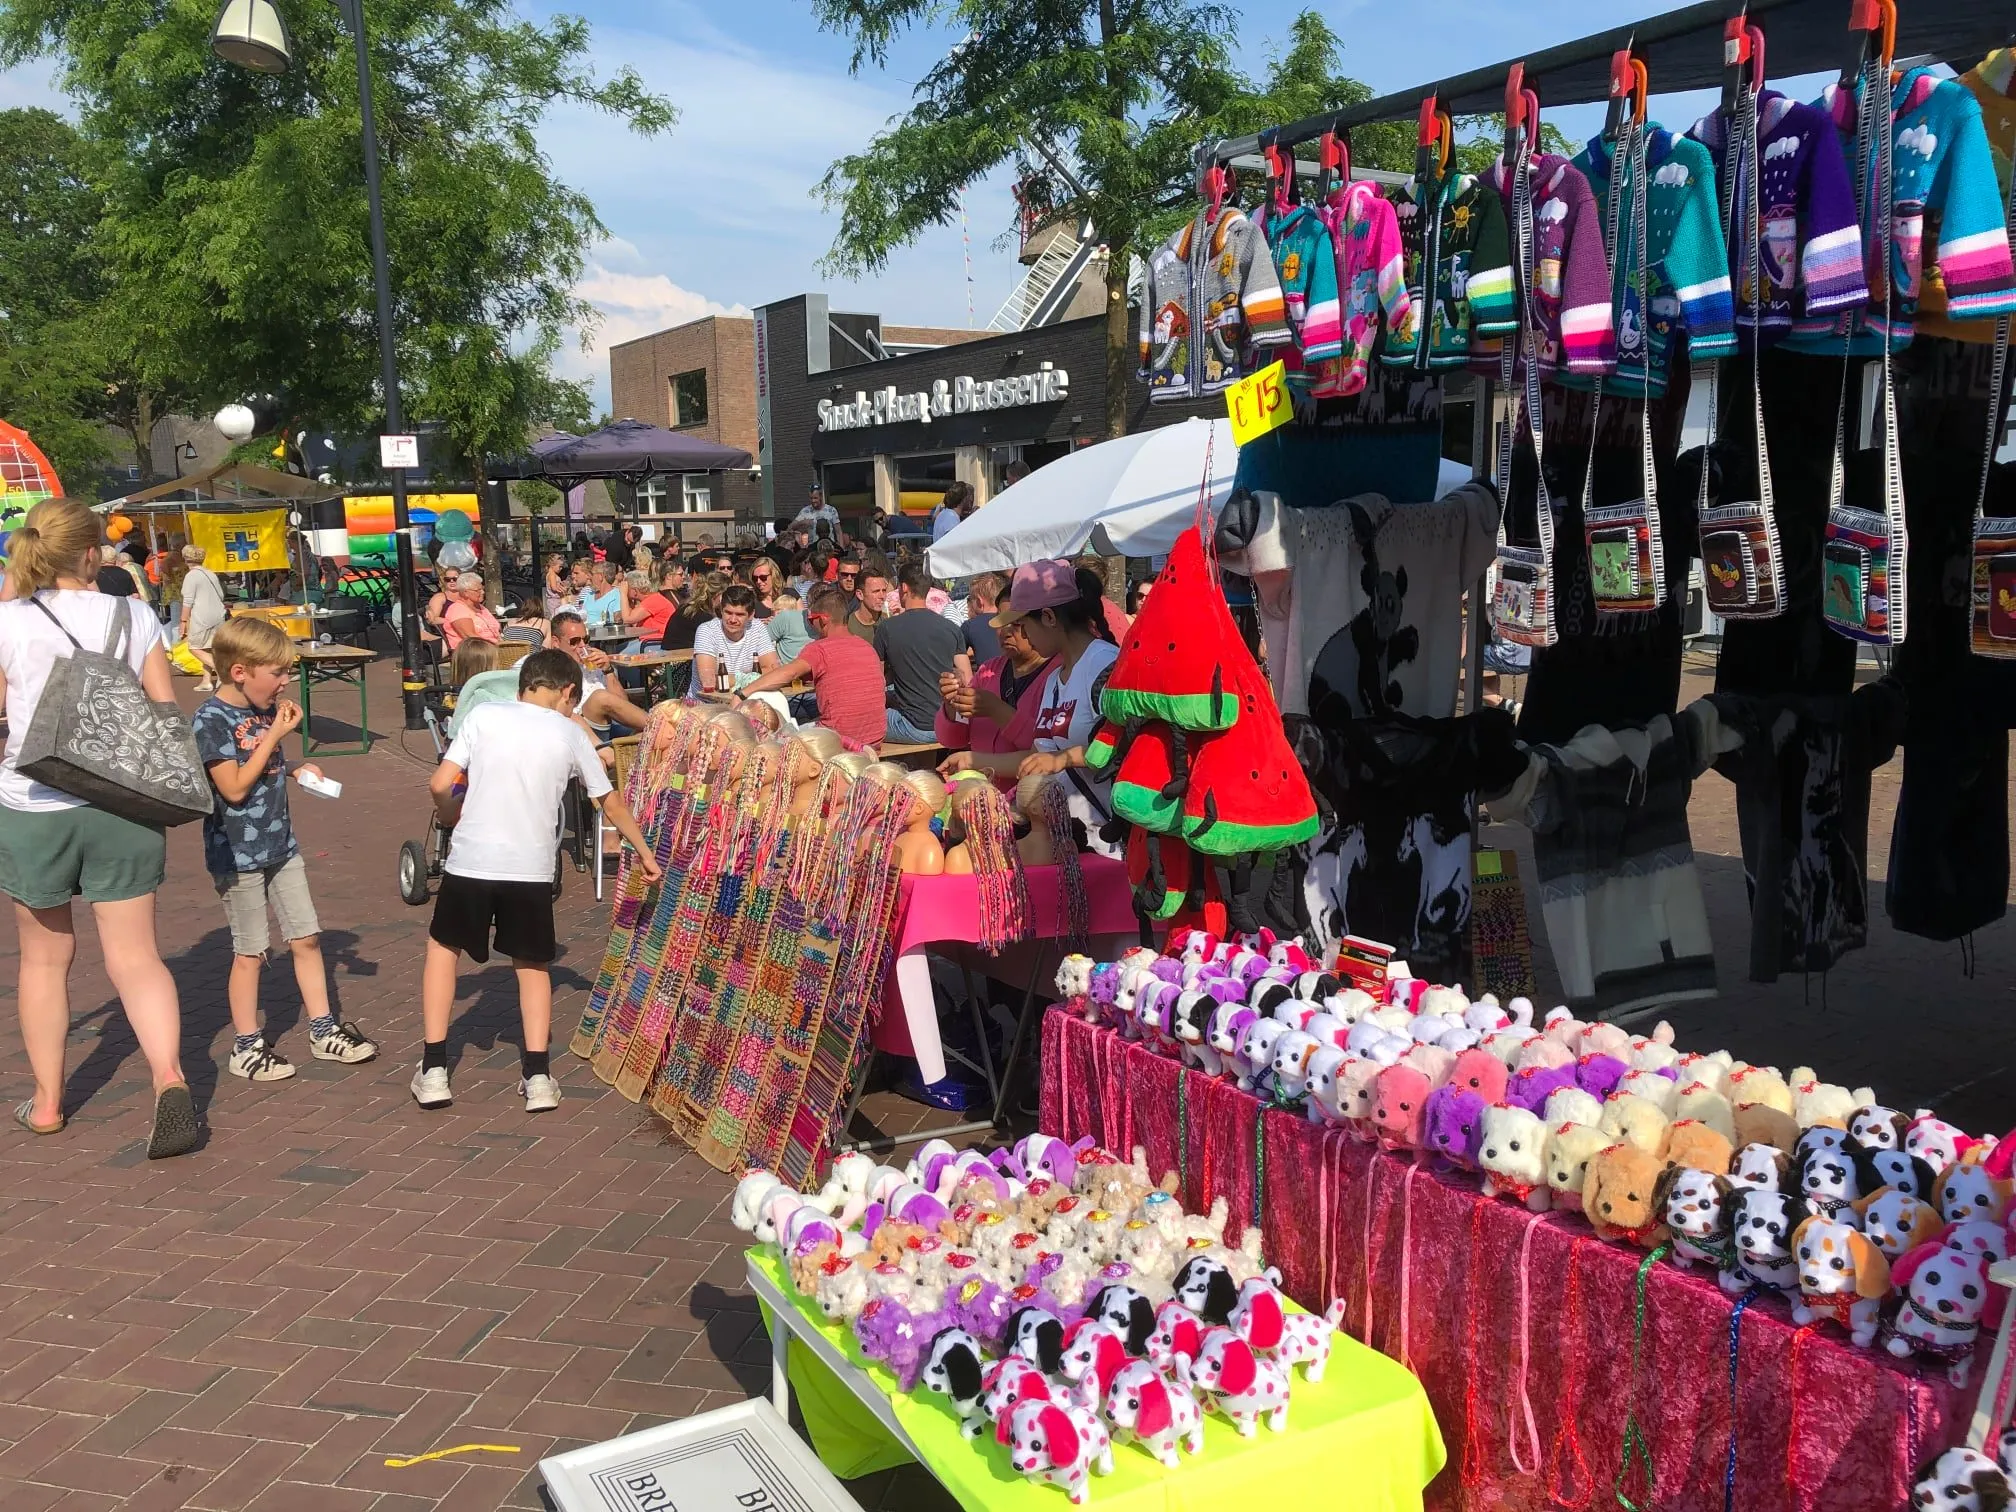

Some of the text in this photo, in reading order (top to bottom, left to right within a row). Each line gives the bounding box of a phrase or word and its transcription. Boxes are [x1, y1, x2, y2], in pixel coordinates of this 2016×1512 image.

[930, 379, 952, 417] &
[954, 361, 1069, 414] Brasserie
[1240, 378, 1251, 393] NU
[1255, 371, 1283, 418] 15
